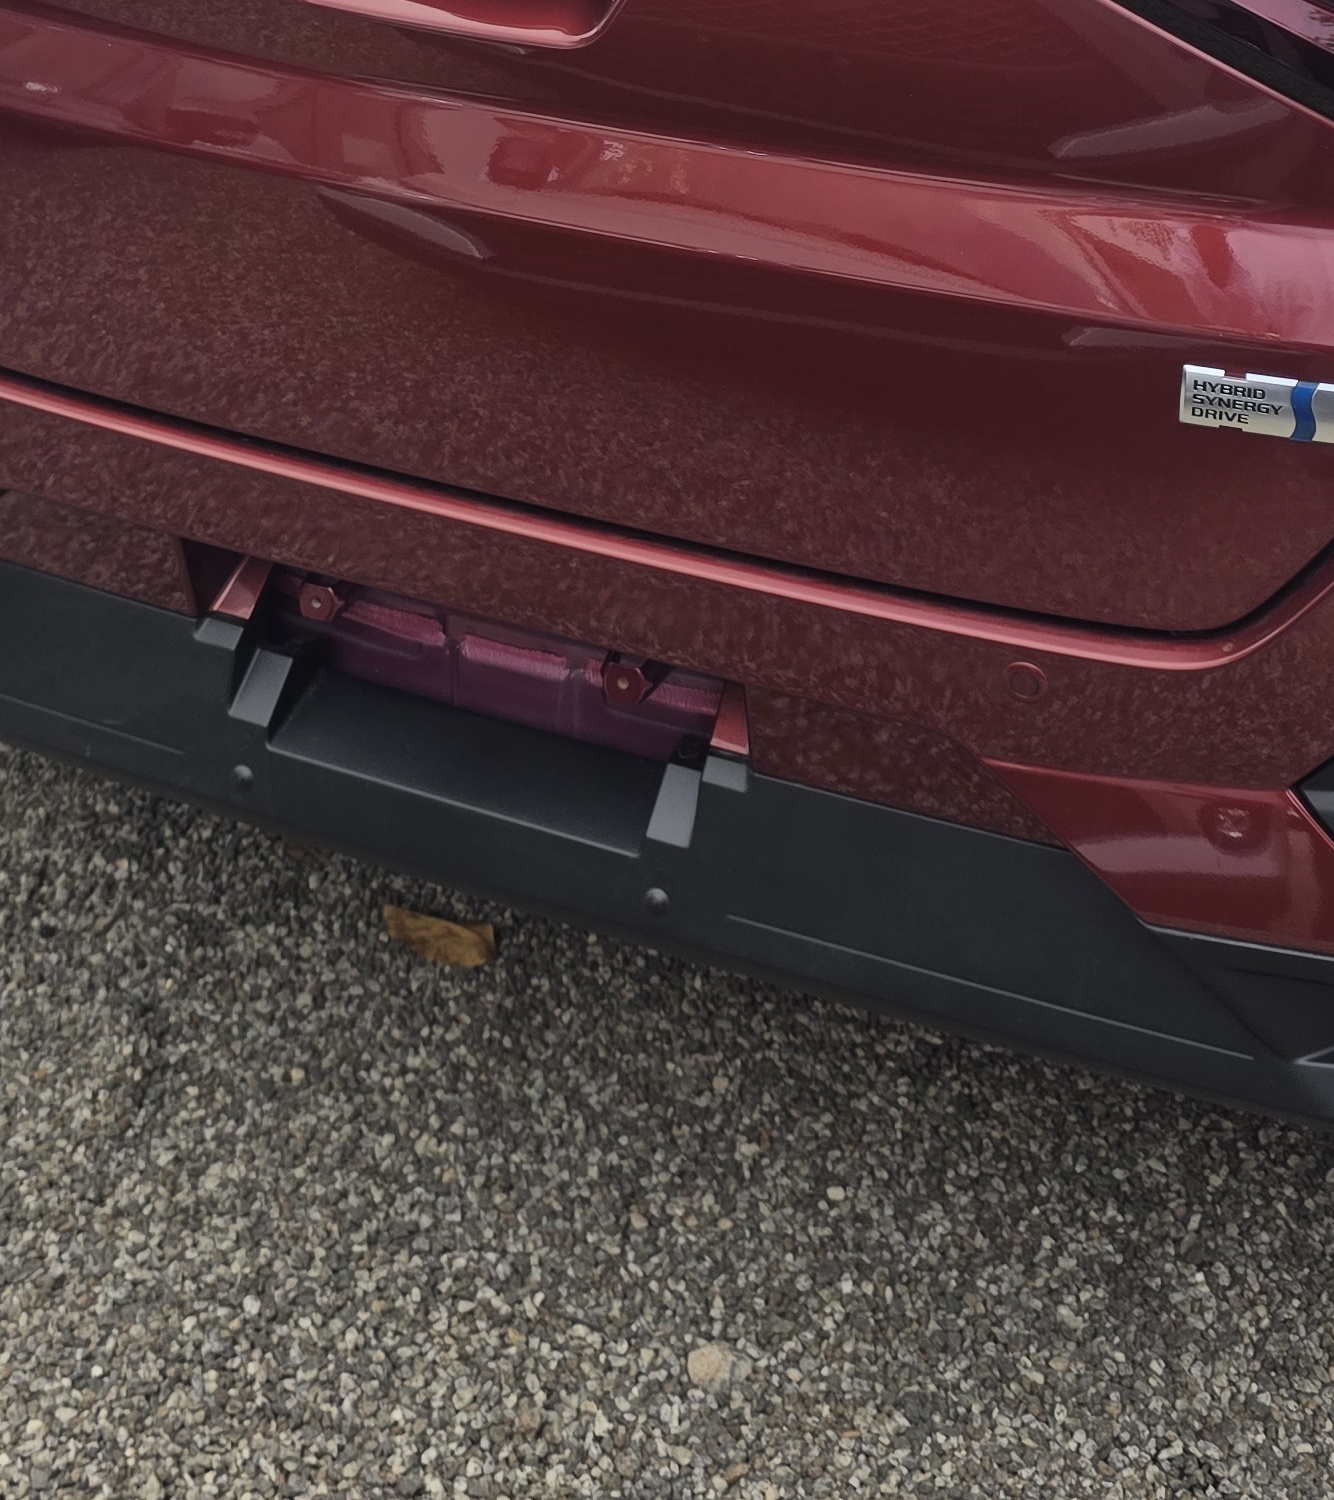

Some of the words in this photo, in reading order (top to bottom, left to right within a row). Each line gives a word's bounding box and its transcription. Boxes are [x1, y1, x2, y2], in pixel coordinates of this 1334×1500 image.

[1193, 379, 1266, 401] HYBRID
[1191, 406, 1249, 425] DRIVE
[1192, 393, 1284, 416] SYNERGY
